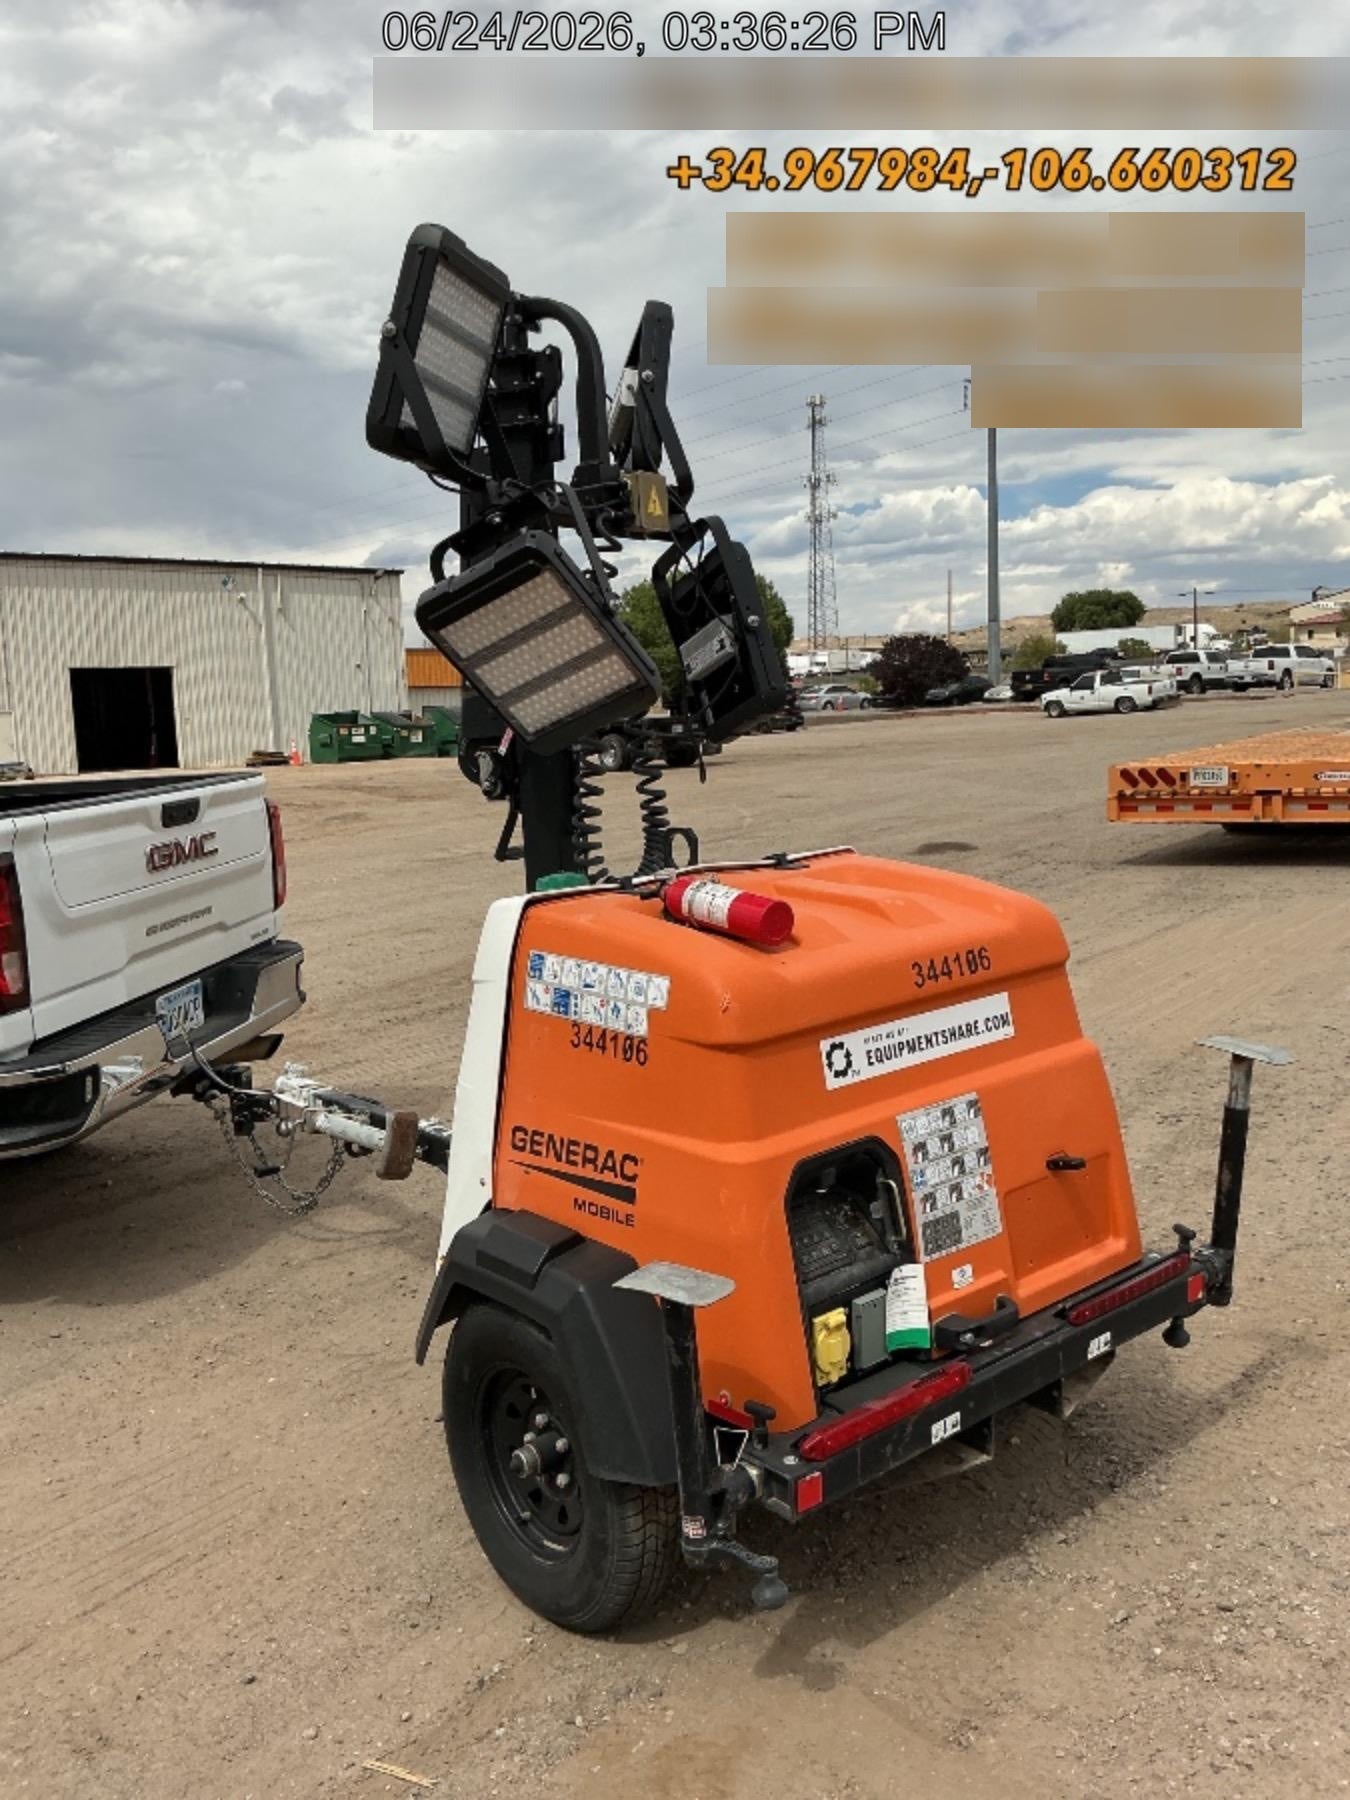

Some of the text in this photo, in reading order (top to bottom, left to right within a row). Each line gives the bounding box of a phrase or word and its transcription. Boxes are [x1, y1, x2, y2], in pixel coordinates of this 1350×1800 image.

[146, 831, 218, 873] GMC
[911, 947, 991, 989] 344106
[570, 1021, 649, 1067] 344106
[866, 1012, 1011, 1067] EQUIPMENTSHARE.COM
[511, 1125, 639, 1183] GENERAC
[573, 1198, 635, 1228] MOBILE
